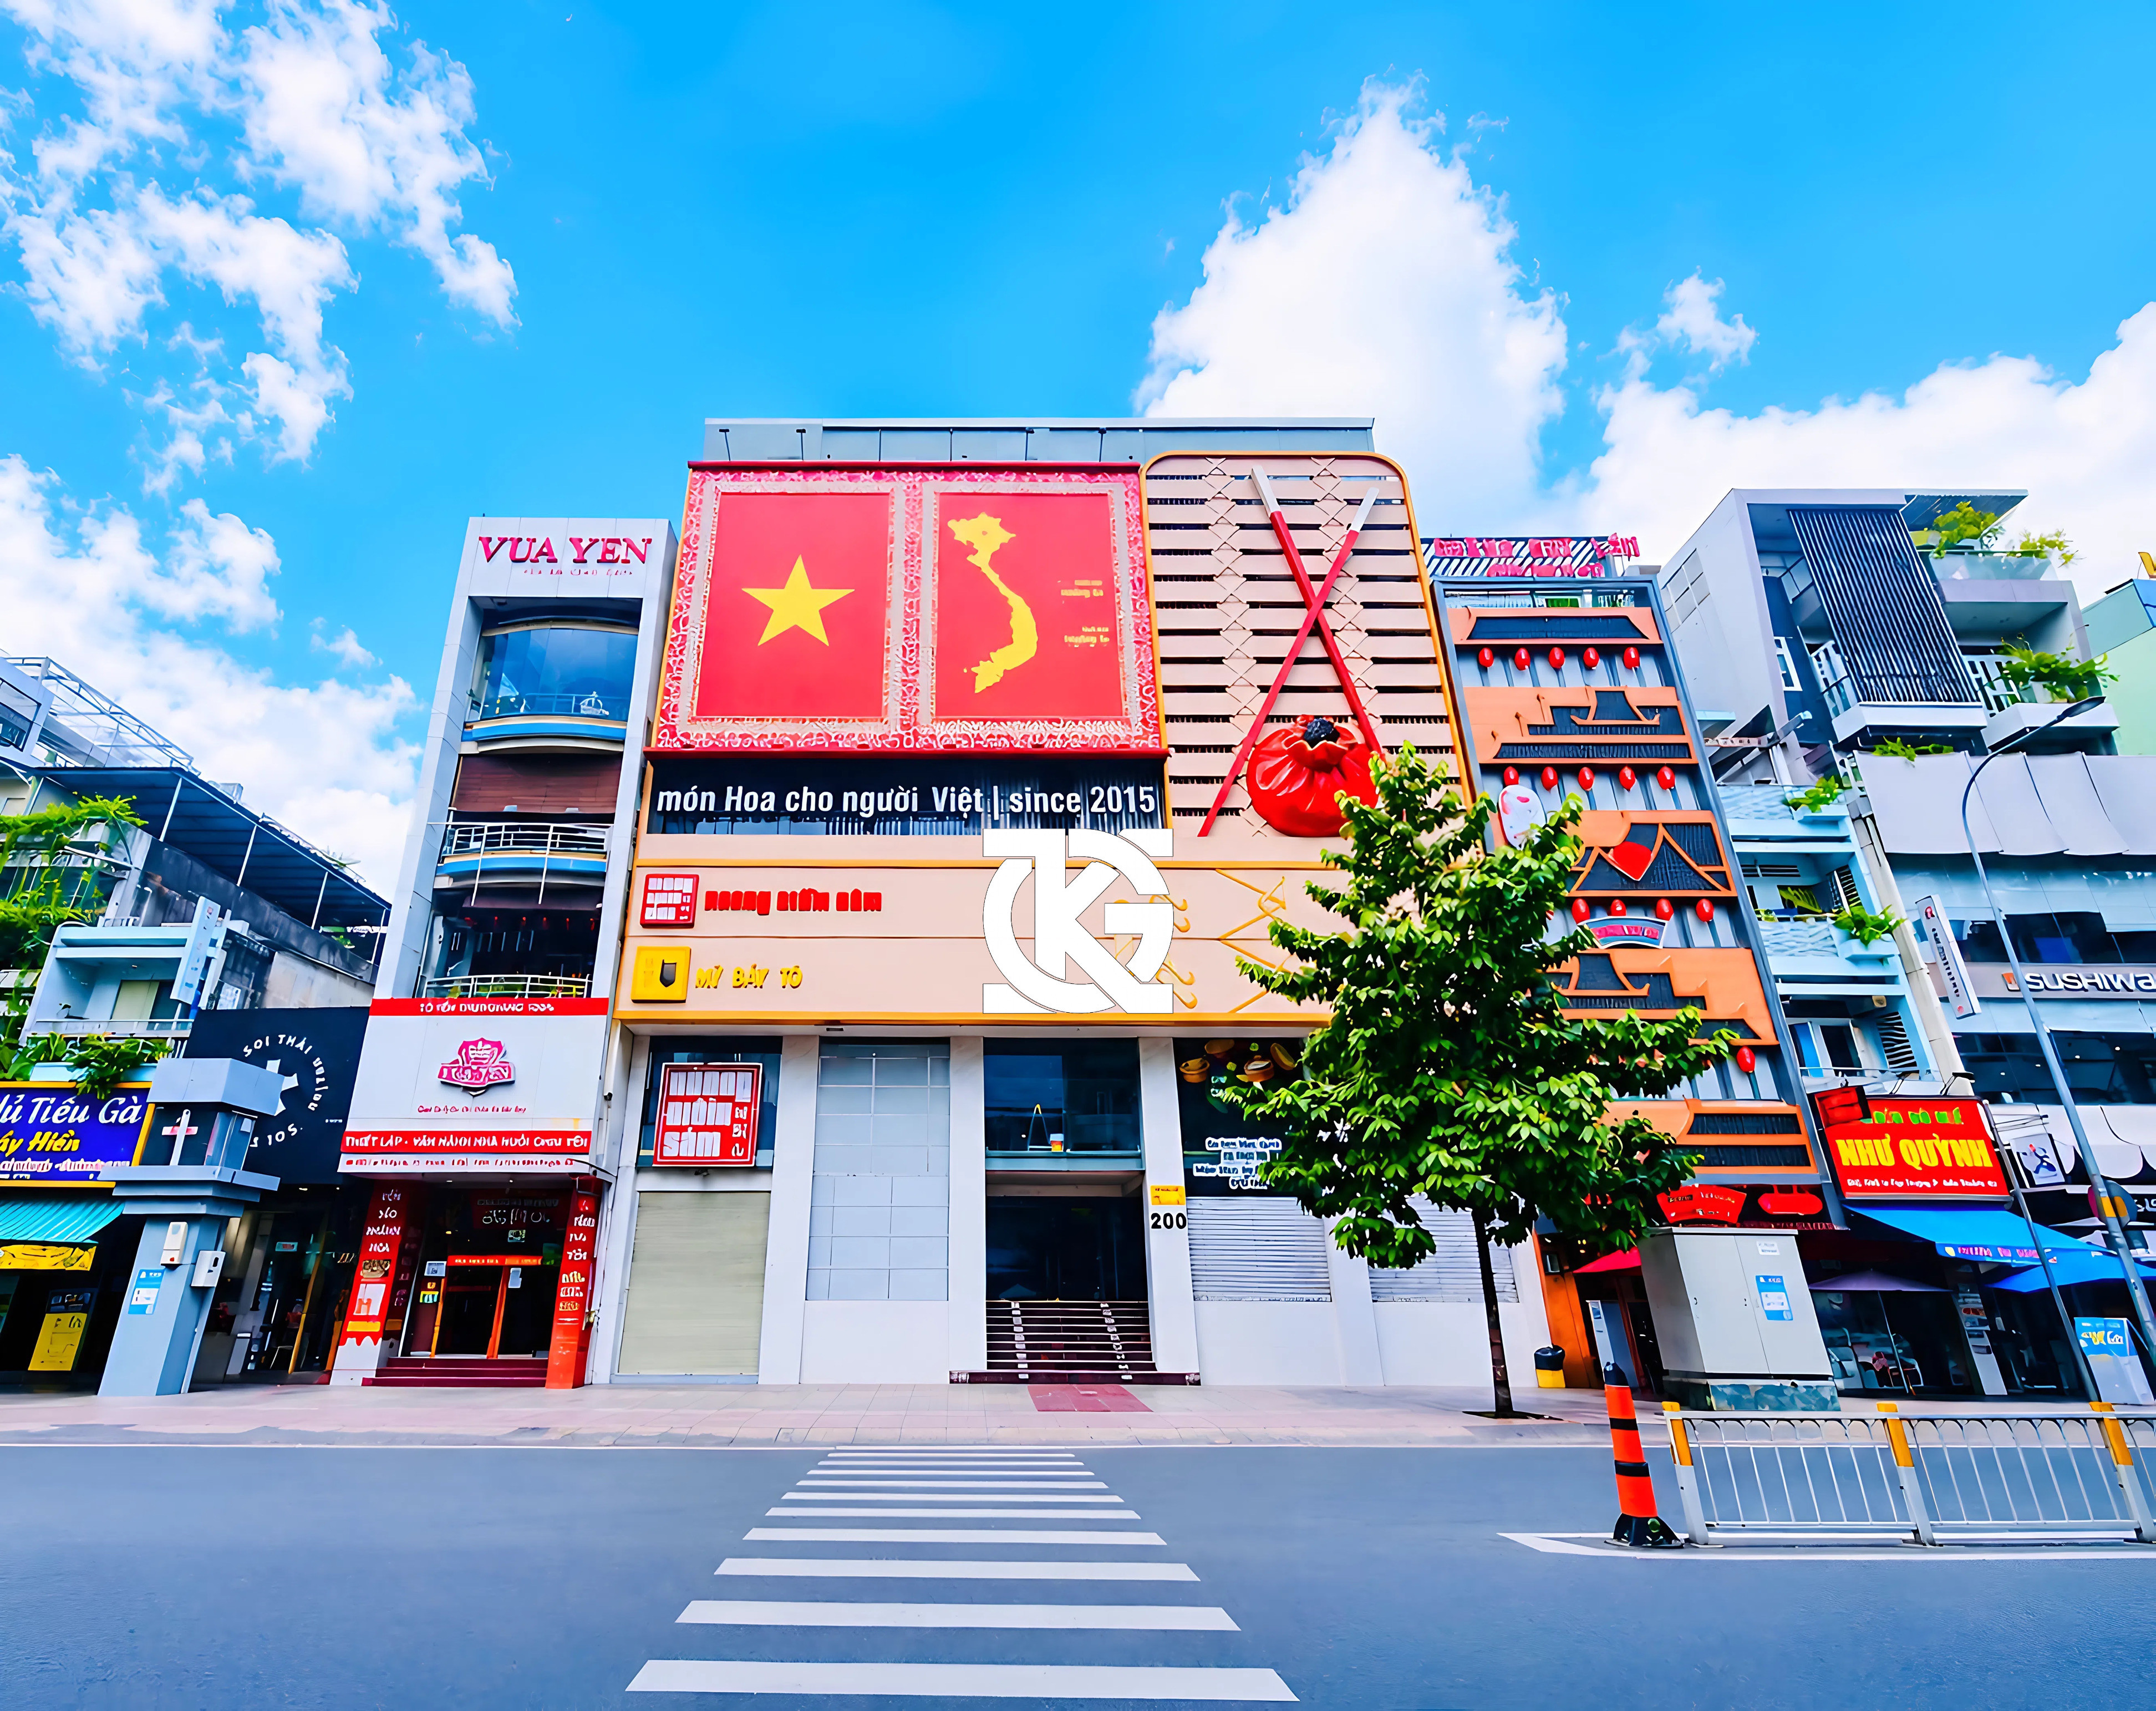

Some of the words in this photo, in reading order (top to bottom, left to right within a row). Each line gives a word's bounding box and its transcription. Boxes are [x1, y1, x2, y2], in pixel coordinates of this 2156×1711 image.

[479, 536, 558, 563] VUA
[569, 536, 653, 564] YEN
[657, 785, 716, 812] món
[725, 785, 776, 812] Hoa
[785, 786, 833, 812] cho
[842, 785, 918, 818] người
[932, 786, 984, 819] Việt
[1009, 786, 1081, 813] since
[1090, 786, 1156, 813] 2015
[243, 1035, 270, 1057] SOI
[98, 1095, 143, 1124] Gà
[1835, 1133, 1895, 1166] NHƯ
[1151, 1212, 1187, 1230] 200
